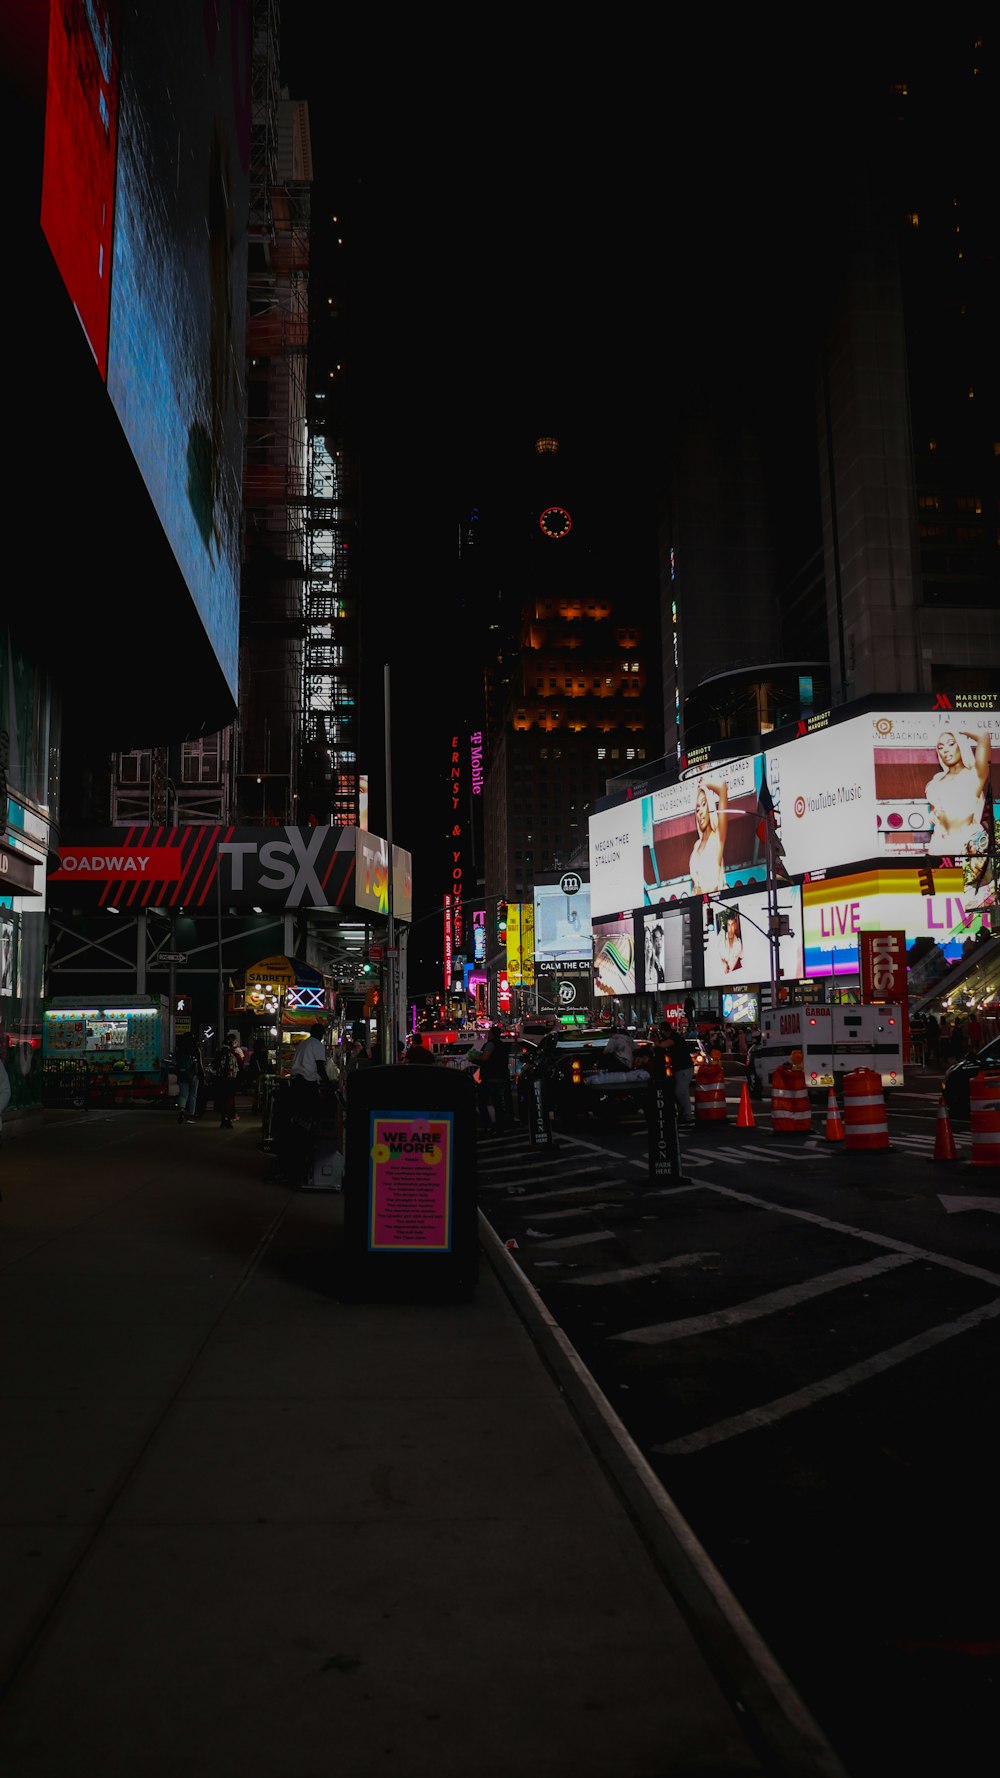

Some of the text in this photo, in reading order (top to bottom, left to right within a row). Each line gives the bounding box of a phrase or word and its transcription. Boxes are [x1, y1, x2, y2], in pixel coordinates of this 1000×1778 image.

[808, 711, 832, 724] MARRIOTT
[808, 720, 829, 731] MARQUIS
[687, 746, 712, 758] MARRIOTT
[450, 736, 461, 811] ERNST
[807, 784, 862, 812] YouTube Music
[452, 824, 462, 837] &
[594, 833, 630, 853] MEGAN THEE
[57, 856, 150, 872] OADWAY
[218, 826, 330, 907] TSX
[594, 851, 621, 867] STALLION
[820, 903, 861, 938] LIVE
[540, 960, 592, 971] CALM THE CH
[872, 935, 899, 992] tkts
[249, 973, 292, 983] SABRETT
[805, 1007, 831, 1017] GARDA
[780, 1013, 801, 1036] GARDA
[656, 1089, 667, 1159] EDITION
[383, 1132, 441, 1143] WE ARE
[389, 1142, 434, 1153] MORE
